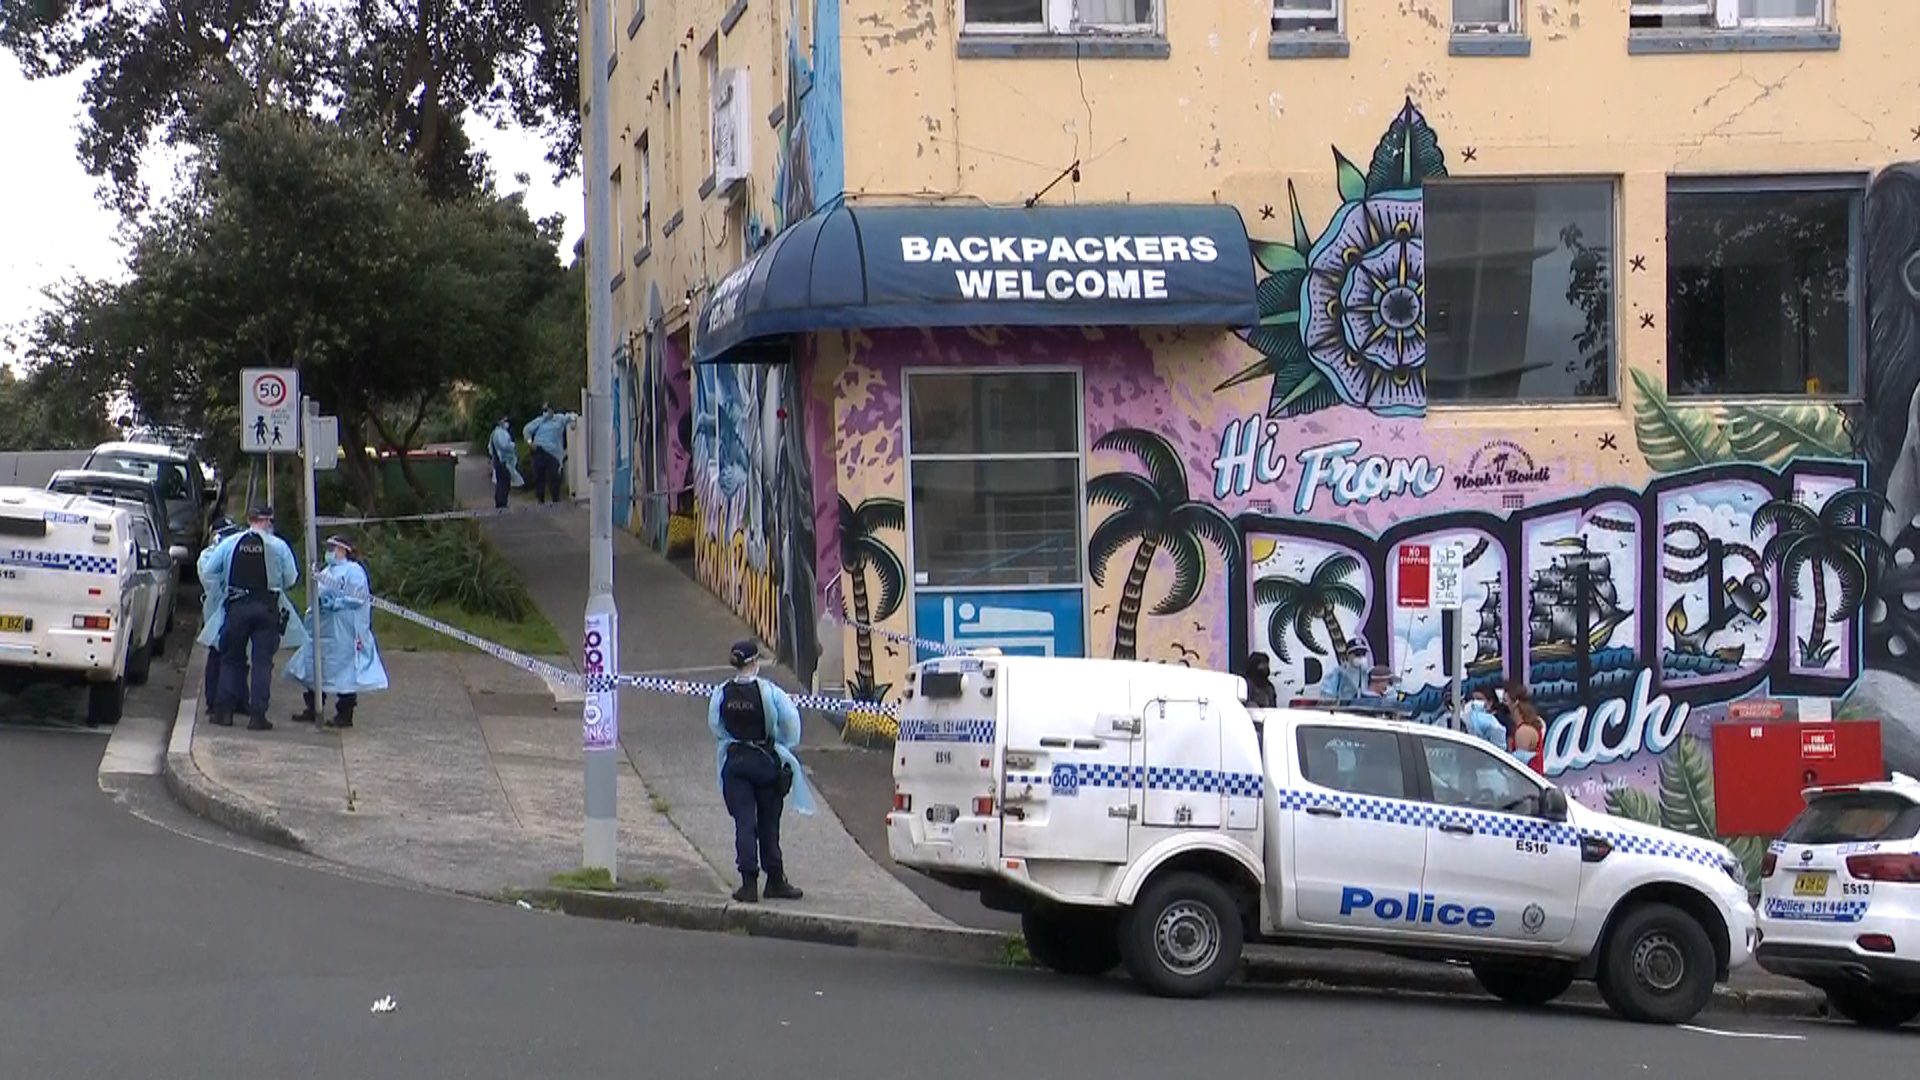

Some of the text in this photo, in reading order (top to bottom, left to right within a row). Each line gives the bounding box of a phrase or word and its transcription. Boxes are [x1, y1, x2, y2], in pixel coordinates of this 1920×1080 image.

[900, 236, 1218, 262] BACKPACKERS
[955, 269, 1168, 299] WELCOME
[260, 383, 281, 399] 50
[1212, 413, 1444, 513] Hi From
[1453, 466, 1550, 490] Noah's Bondi
[11, 550, 60, 562] 131 444
[1408, 547, 1421, 557] NO
[1400, 557, 1429, 565] STOPPING
[727, 701, 754, 710] POLICE
[1543, 667, 1691, 778] ach
[1811, 735, 1826, 744] FIRE
[1803, 743, 1833, 753] HYDRANT
[1052, 773, 1078, 788] 000
[1515, 839, 1549, 855] ES16
[1842, 882, 1870, 895] ES13
[1339, 886, 1496, 928] Police
[1776, 899, 1849, 914] Police 131 444
